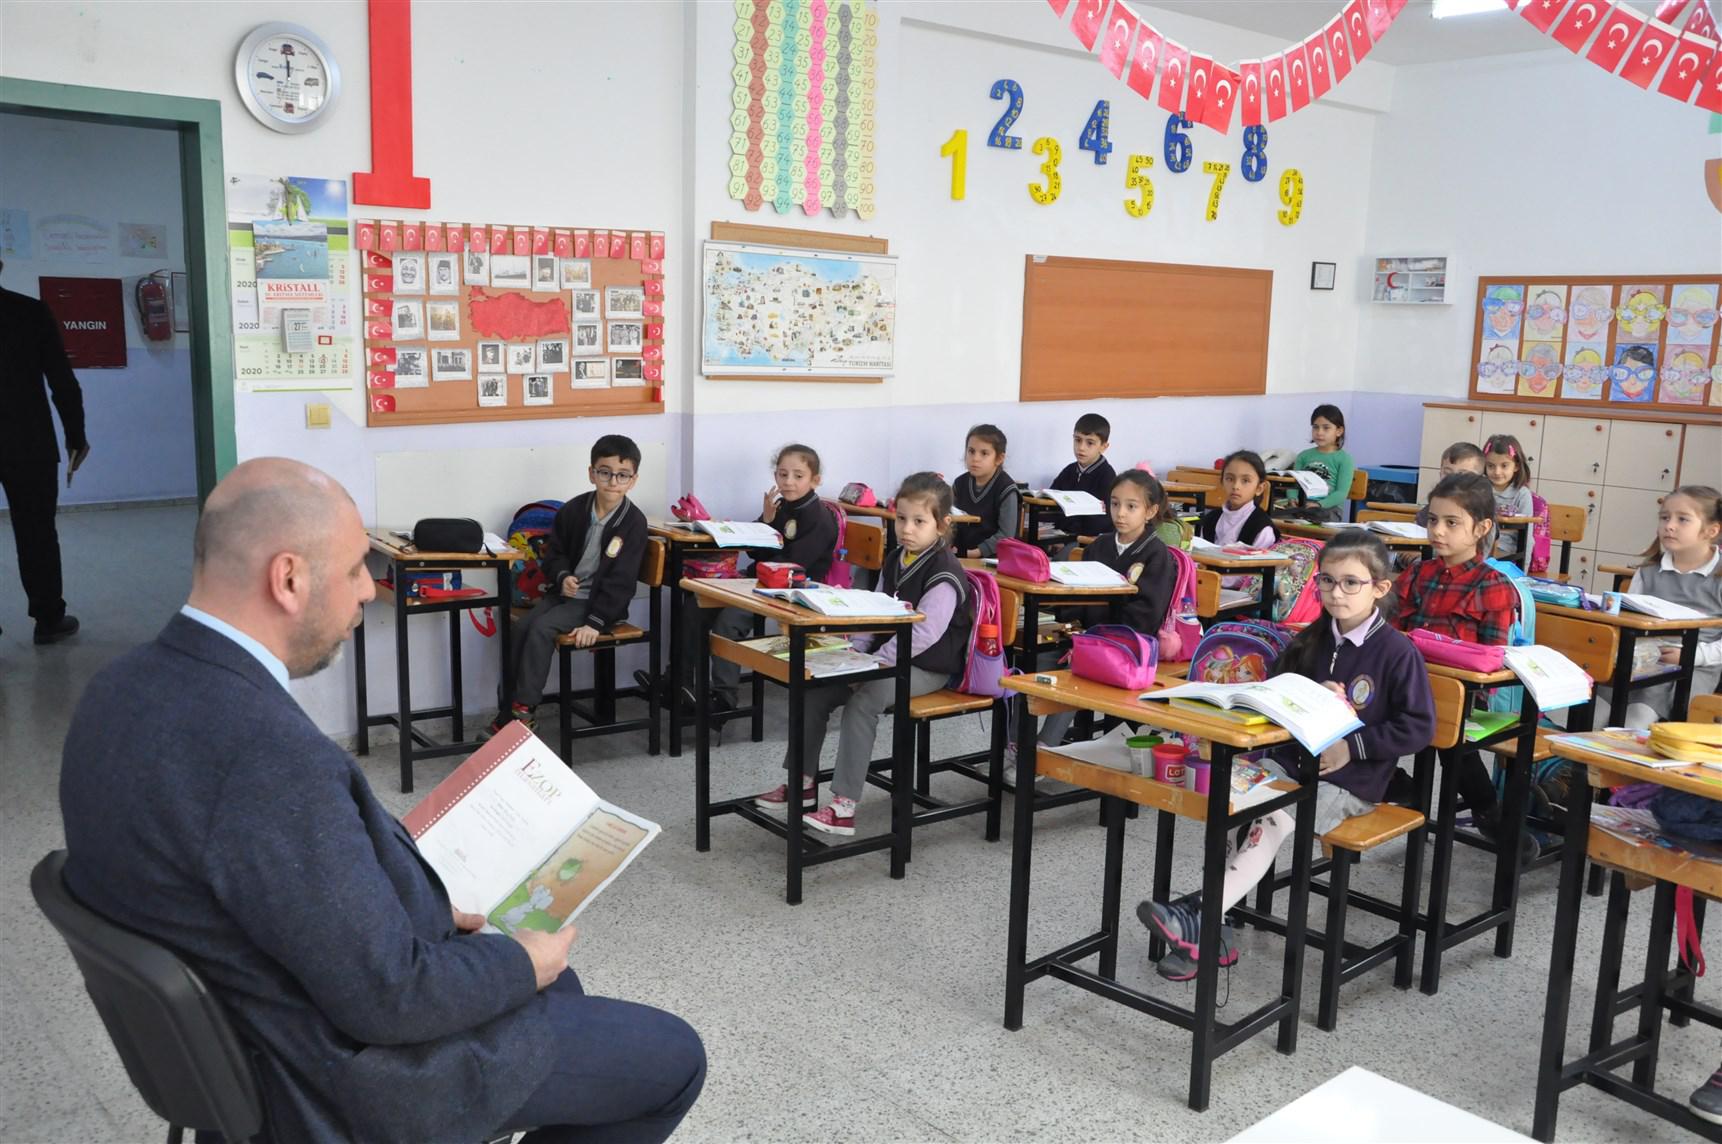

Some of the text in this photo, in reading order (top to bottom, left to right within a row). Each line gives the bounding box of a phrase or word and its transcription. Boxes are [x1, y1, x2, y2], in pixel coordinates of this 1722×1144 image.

[738, 24, 750, 37] 21
[768, 29, 781, 41] 23
[783, 42, 794, 54] 24
[797, 34, 809, 46] 25
[826, 40, 837, 50] 27
[851, 43, 863, 55] 29
[739, 3, 750, 14] 11
[770, 7, 781, 18] 13
[784, 20, 794, 31] 14
[800, 12, 808, 23] 15
[814, 25, 822, 36] 16
[827, 17, 836, 28] 17
[851, 22, 861, 33] 19
[863, 35, 876, 46] 20
[864, 14, 876, 25] 10
[738, 47, 749, 58] 31
[767, 52, 780, 63] 33
[782, 64, 793, 75] 34
[798, 56, 808, 68] 35
[825, 61, 836, 71] 37
[850, 65, 860, 76] 39
[736, 70, 748, 82] 41
[765, 74, 778, 86] 43
[779, 87, 792, 97] 44
[796, 78, 807, 89] 45
[823, 83, 834, 93] 47
[849, 86, 860, 97] 49
[736, 92, 747, 104] 51
[750, 106, 763, 117] 52
[766, 96, 778, 108] 53
[780, 109, 792, 120] 54
[849, 108, 860, 119] 59
[862, 120, 874, 130] 60
[987, 79, 1024, 149] 2
[735, 115, 746, 126] 61
[763, 118, 777, 130] 63
[778, 131, 790, 142] 64
[795, 123, 806, 135] 65
[848, 129, 859, 140] 69
[862, 142, 874, 152] 70
[735, 138, 746, 149] 71
[764, 140, 776, 152] 73
[778, 153, 790, 164] 74
[794, 144, 805, 156] 75
[848, 150, 859, 161] 79
[1079, 100, 1112, 165] 4
[1164, 112, 1193, 173] 6
[940, 129, 968, 200] 1
[1028, 137, 1062, 205] 3
[1241, 125, 1268, 182] 8
[733, 160, 744, 171] 81
[746, 172, 760, 184] 82
[763, 162, 775, 174] 83
[777, 176, 789, 186] 84
[791, 166, 803, 177] 85
[860, 184, 873, 194] 90
[733, 182, 745, 194] 91
[747, 196, 760, 207] 92
[763, 184, 775, 196] 93
[777, 198, 789, 209] 94
[792, 189, 804, 200] 95
[821, 190, 832, 201] 97
[847, 193, 858, 204] 99
[861, 203, 874, 212] 100
[1124, 155, 1154, 218] 5
[1203, 162, 1230, 221] 7
[1278, 169, 1304, 225] 9
[64, 321, 106, 330] YANGIN
